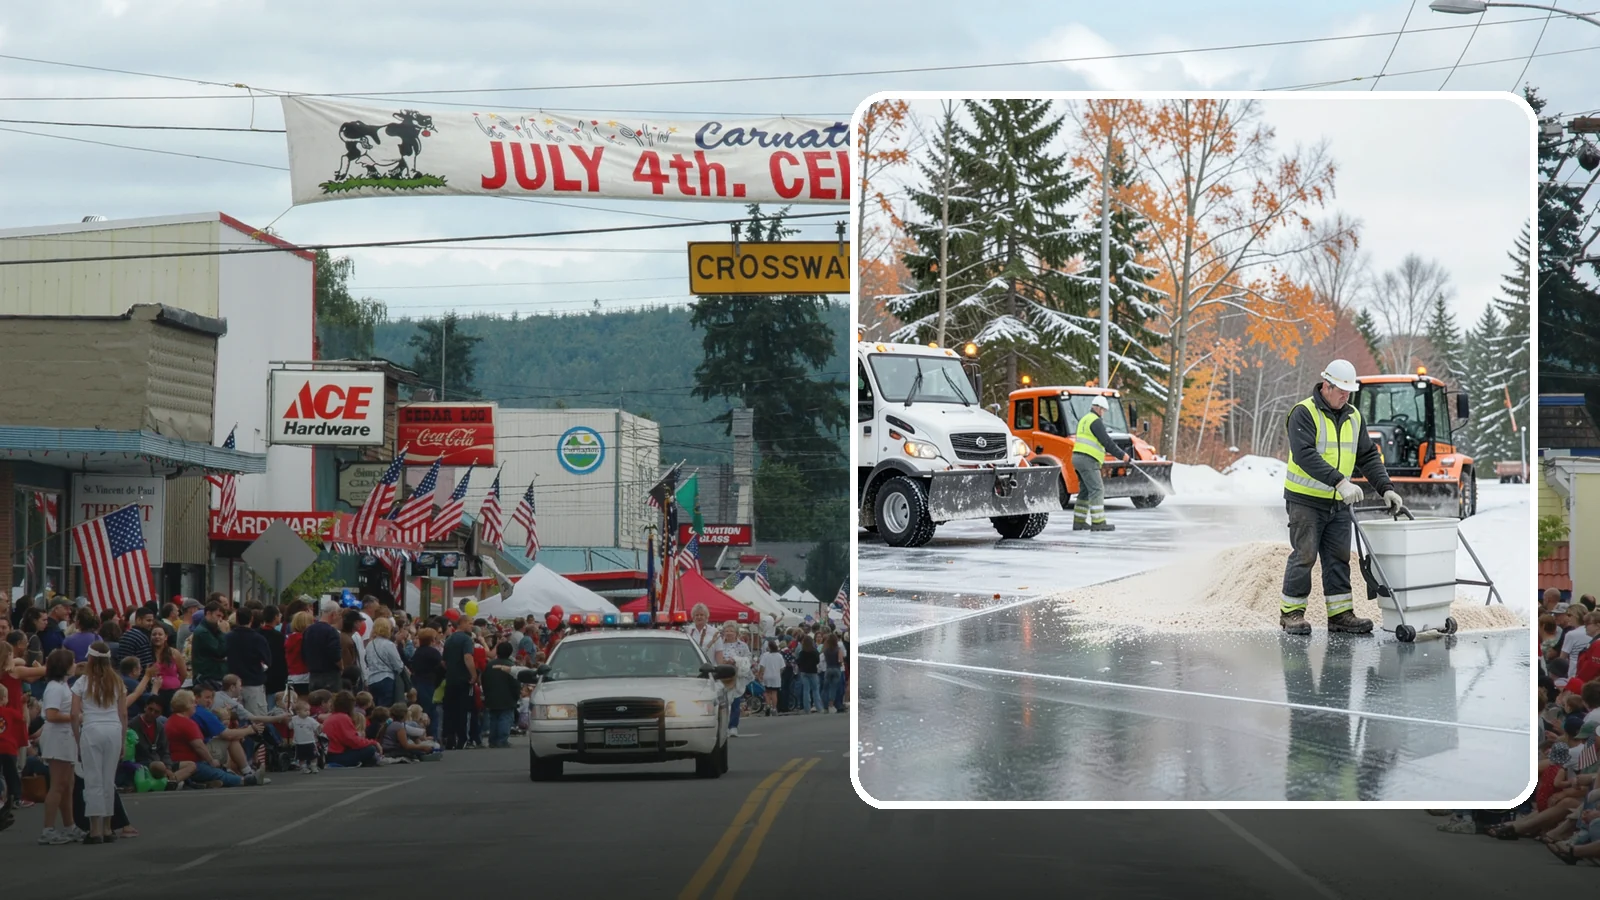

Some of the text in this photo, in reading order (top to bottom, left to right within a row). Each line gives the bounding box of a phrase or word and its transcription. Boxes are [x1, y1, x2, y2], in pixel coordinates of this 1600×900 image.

[481, 141, 605, 192] JULY
[632, 149, 746, 198] 4th.
[696, 254, 850, 280] CROSSWA
[283, 380, 374, 420] ACE
[406, 409, 452, 422] CEDAR
[283, 421, 371, 437] Hardware
[416, 428, 477, 447] Coca-Cola
[353, 467, 386, 482] Simpl
[83, 485, 155, 495] St. Vincent de Paul
[80, 503, 154, 522] THT
[212, 516, 330, 535] HARDARE
[688, 526, 741, 535] CRNATION
[699, 535, 730, 543] GLASS
